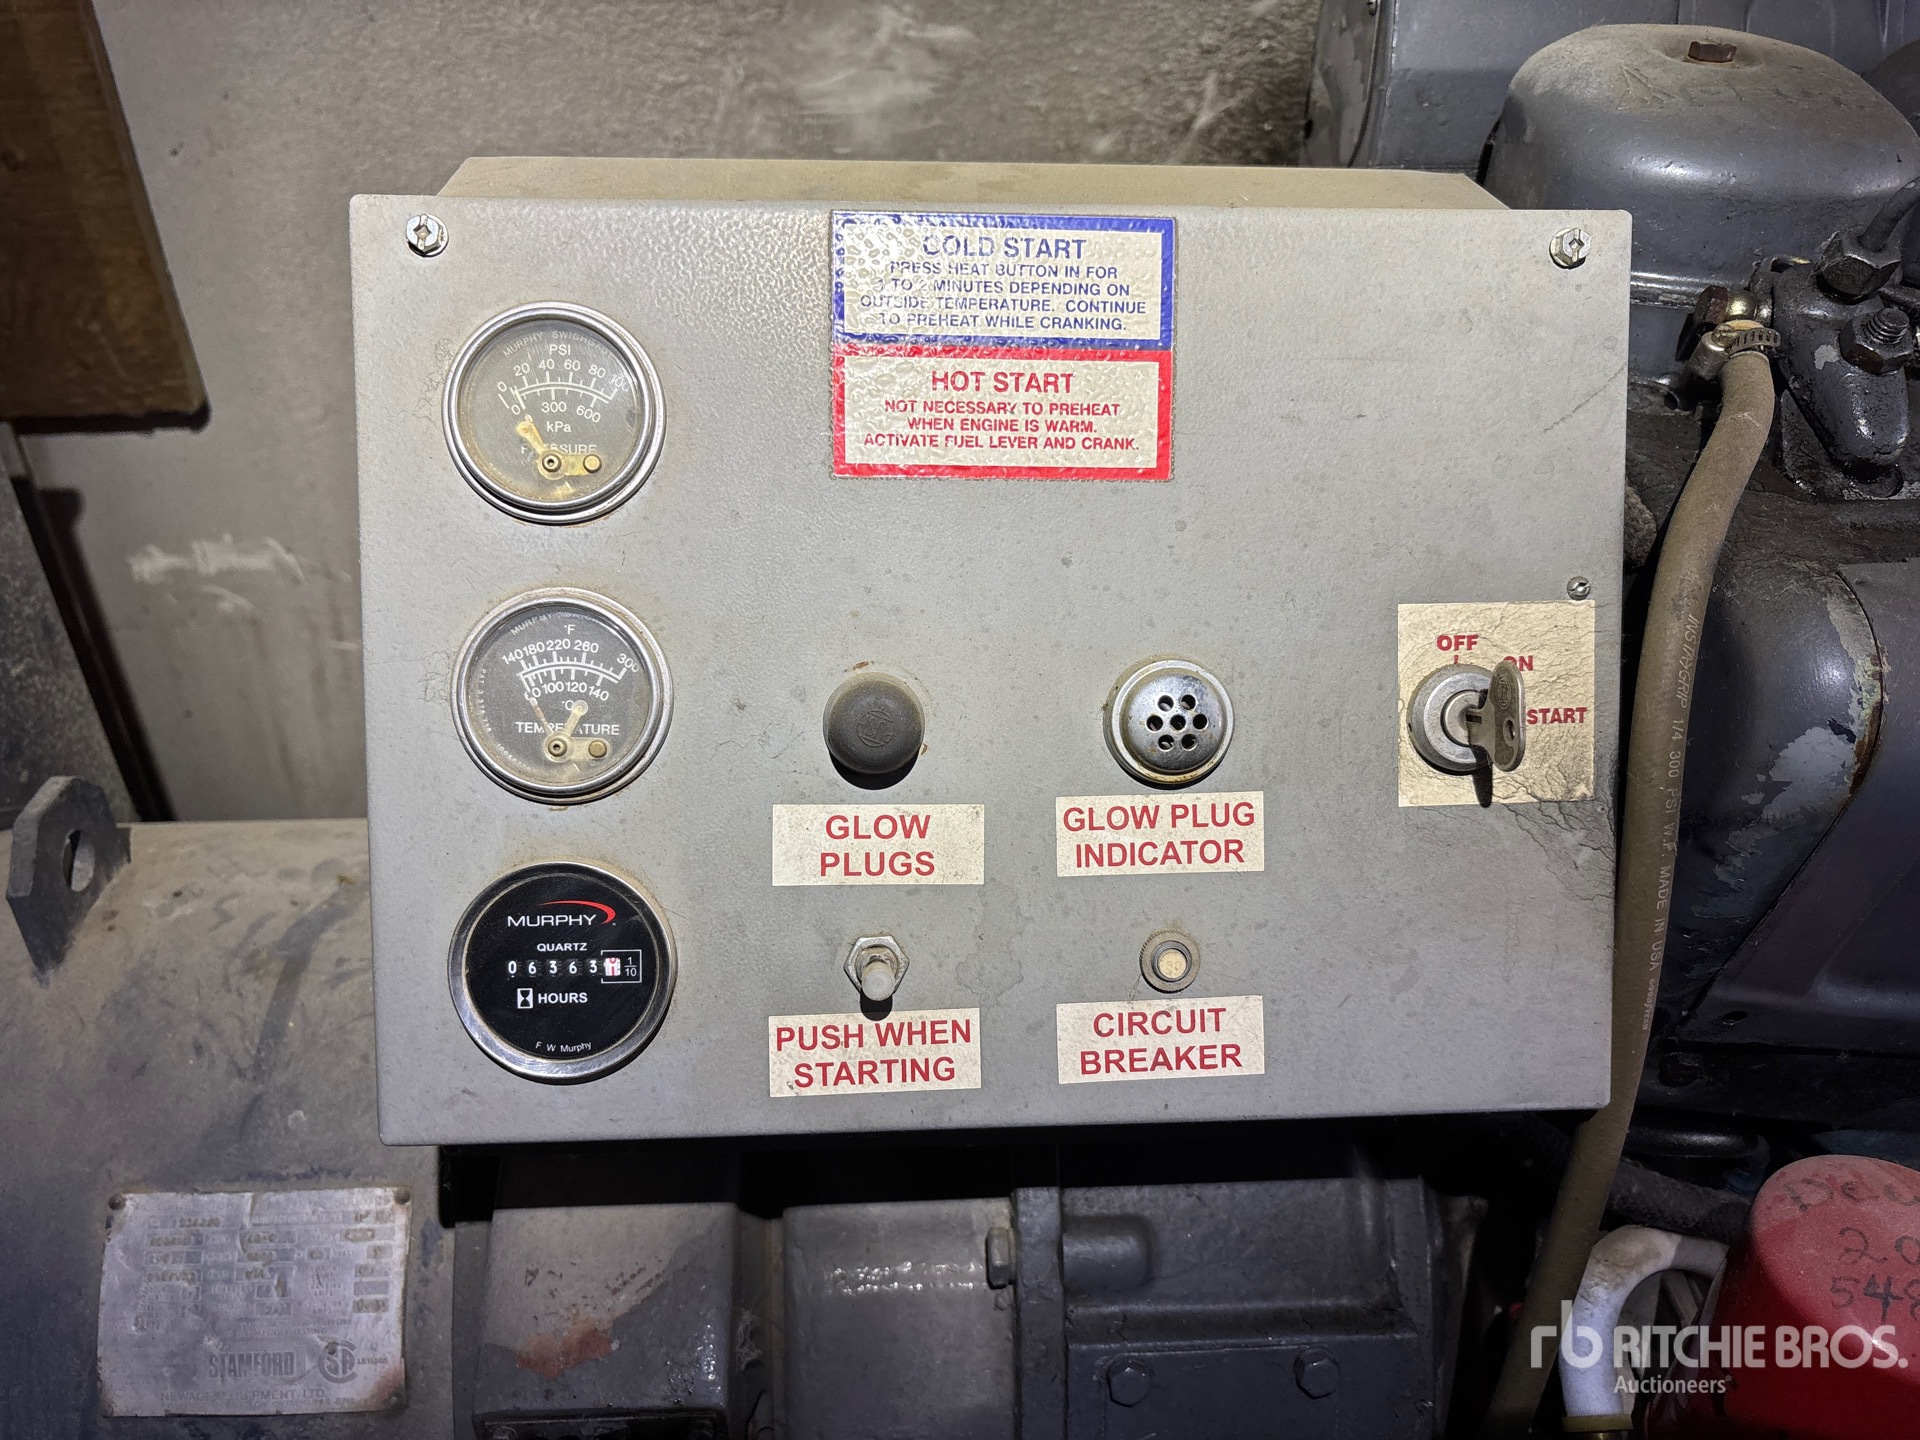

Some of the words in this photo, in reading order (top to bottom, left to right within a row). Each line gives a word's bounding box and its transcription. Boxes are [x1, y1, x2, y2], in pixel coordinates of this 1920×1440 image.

[923, 234, 995, 257] COLD
[1004, 237, 1086, 259] START
[891, 261, 942, 275] PRESS
[948, 263, 989, 277] HEAT
[996, 264, 1058, 278] BUTTON
[1065, 266, 1079, 278] IN
[1086, 266, 1118, 279] FOR
[891, 278, 913, 291] TO
[933, 279, 1001, 293] MINUTES
[1009, 282, 1100, 296] DEPENDING
[1107, 284, 1130, 297] ON
[860, 295, 928, 309] OUTSIDE
[935, 297, 1055, 312] TEMPERATURE.
[1066, 300, 1146, 314] CONTINUE
[879, 312, 900, 325] TO
[907, 314, 978, 327] PREHEAT
[985, 315, 1034, 328] WHILE
[1040, 316, 1127, 330] CRANKING.
[502, 332, 544, 358] MURPHY
[549, 344, 571, 356] PSI
[497, 381, 507, 393] 0
[513, 362, 531, 377] 20
[538, 359, 555, 370] 40
[564, 359, 580, 371] 60
[588, 364, 606, 379] 80
[610, 373, 631, 392] 100
[931, 371, 985, 391] HOT
[993, 372, 1074, 393] START
[511, 404, 520, 415] 0
[541, 402, 567, 413] 300
[576, 405, 601, 423] 600
[885, 400, 917, 413] NOT
[923, 400, 1017, 415] NECESSARY
[1024, 402, 1043, 415] TO
[1049, 403, 1120, 416] PREHEAT
[546, 421, 571, 432] kPa
[907, 418, 954, 431] WHEN
[960, 419, 1018, 432] ENGINE
[1024, 420, 1039, 432] IS
[1045, 420, 1097, 433] WARM.
[864, 433, 938, 447] ACTIVATE
[944, 435, 982, 448] FUEL
[989, 435, 1038, 449] LEVER
[1043, 436, 1075, 449] AND
[1081, 437, 1139, 450] CRANK.
[1436, 635, 1479, 651] OFF
[501, 650, 523, 665] 140
[523, 642, 546, 657] 180
[546, 639, 571, 650] 220
[574, 640, 599, 653] 260
[616, 653, 640, 673] 300
[542, 682, 564, 694] 100
[566, 682, 587, 693] 120
[588, 685, 609, 701] 140
[1526, 707, 1588, 725] START
[515, 722, 620, 736] TEMPETURE
[1671, 719, 1684, 741] 1/4
[1668, 751, 1681, 778] 300
[1665, 787, 1678, 814] PSI
[826, 815, 931, 840] GLOW
[1063, 805, 1160, 832] GLOW
[1171, 802, 1255, 828] PLUG
[820, 851, 936, 877] PLUGS
[1075, 839, 1245, 868] INDICATOR
[1656, 866, 1671, 910] MADE
[507, 914, 597, 927] MURPHY
[1654, 919, 1667, 933] IN
[537, 942, 587, 952] QUARTZ
[1649, 940, 1662, 971] USA
[538, 992, 588, 1004] HOURS
[1093, 1008, 1227, 1038] CIRCUIT
[776, 1023, 864, 1052] PUSH
[874, 1019, 971, 1048] WHEN
[535, 1042, 542, 1050] F
[546, 1043, 556, 1052] W
[560, 1041, 592, 1053] Murphy
[1080, 1043, 1242, 1075] BREAKER
[794, 1057, 956, 1088] STARTING
[208, 1351, 295, 1379] STAMFORD
